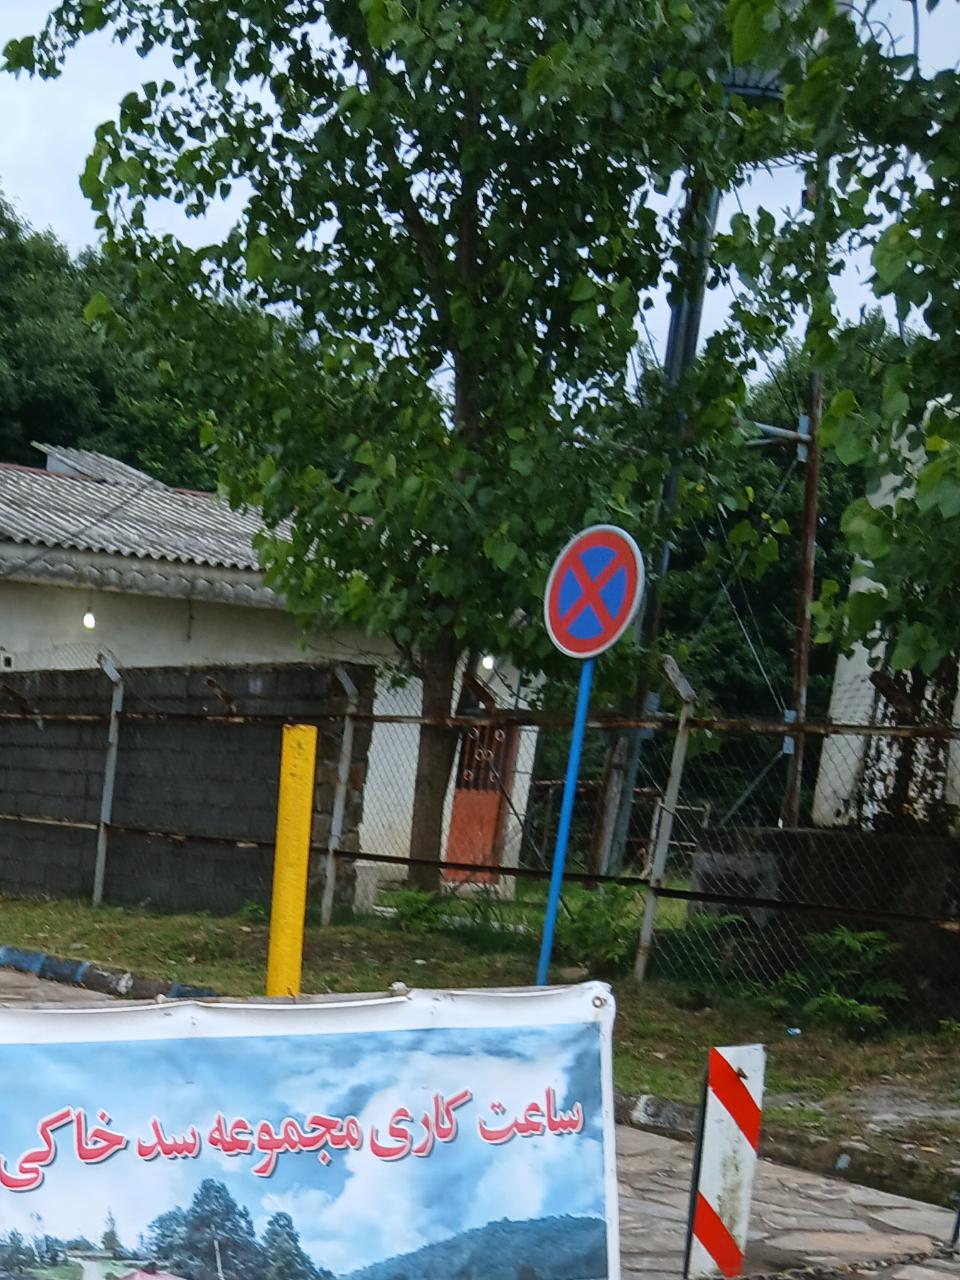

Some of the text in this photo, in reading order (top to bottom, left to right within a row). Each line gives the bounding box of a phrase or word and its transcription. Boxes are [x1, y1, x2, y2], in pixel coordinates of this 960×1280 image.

[137, 1115, 201, 1161] سد
[208, 1109, 364, 1178] مجموعه
[369, 1089, 473, 1161] کاری
[477, 1087, 585, 1146] ساعت
